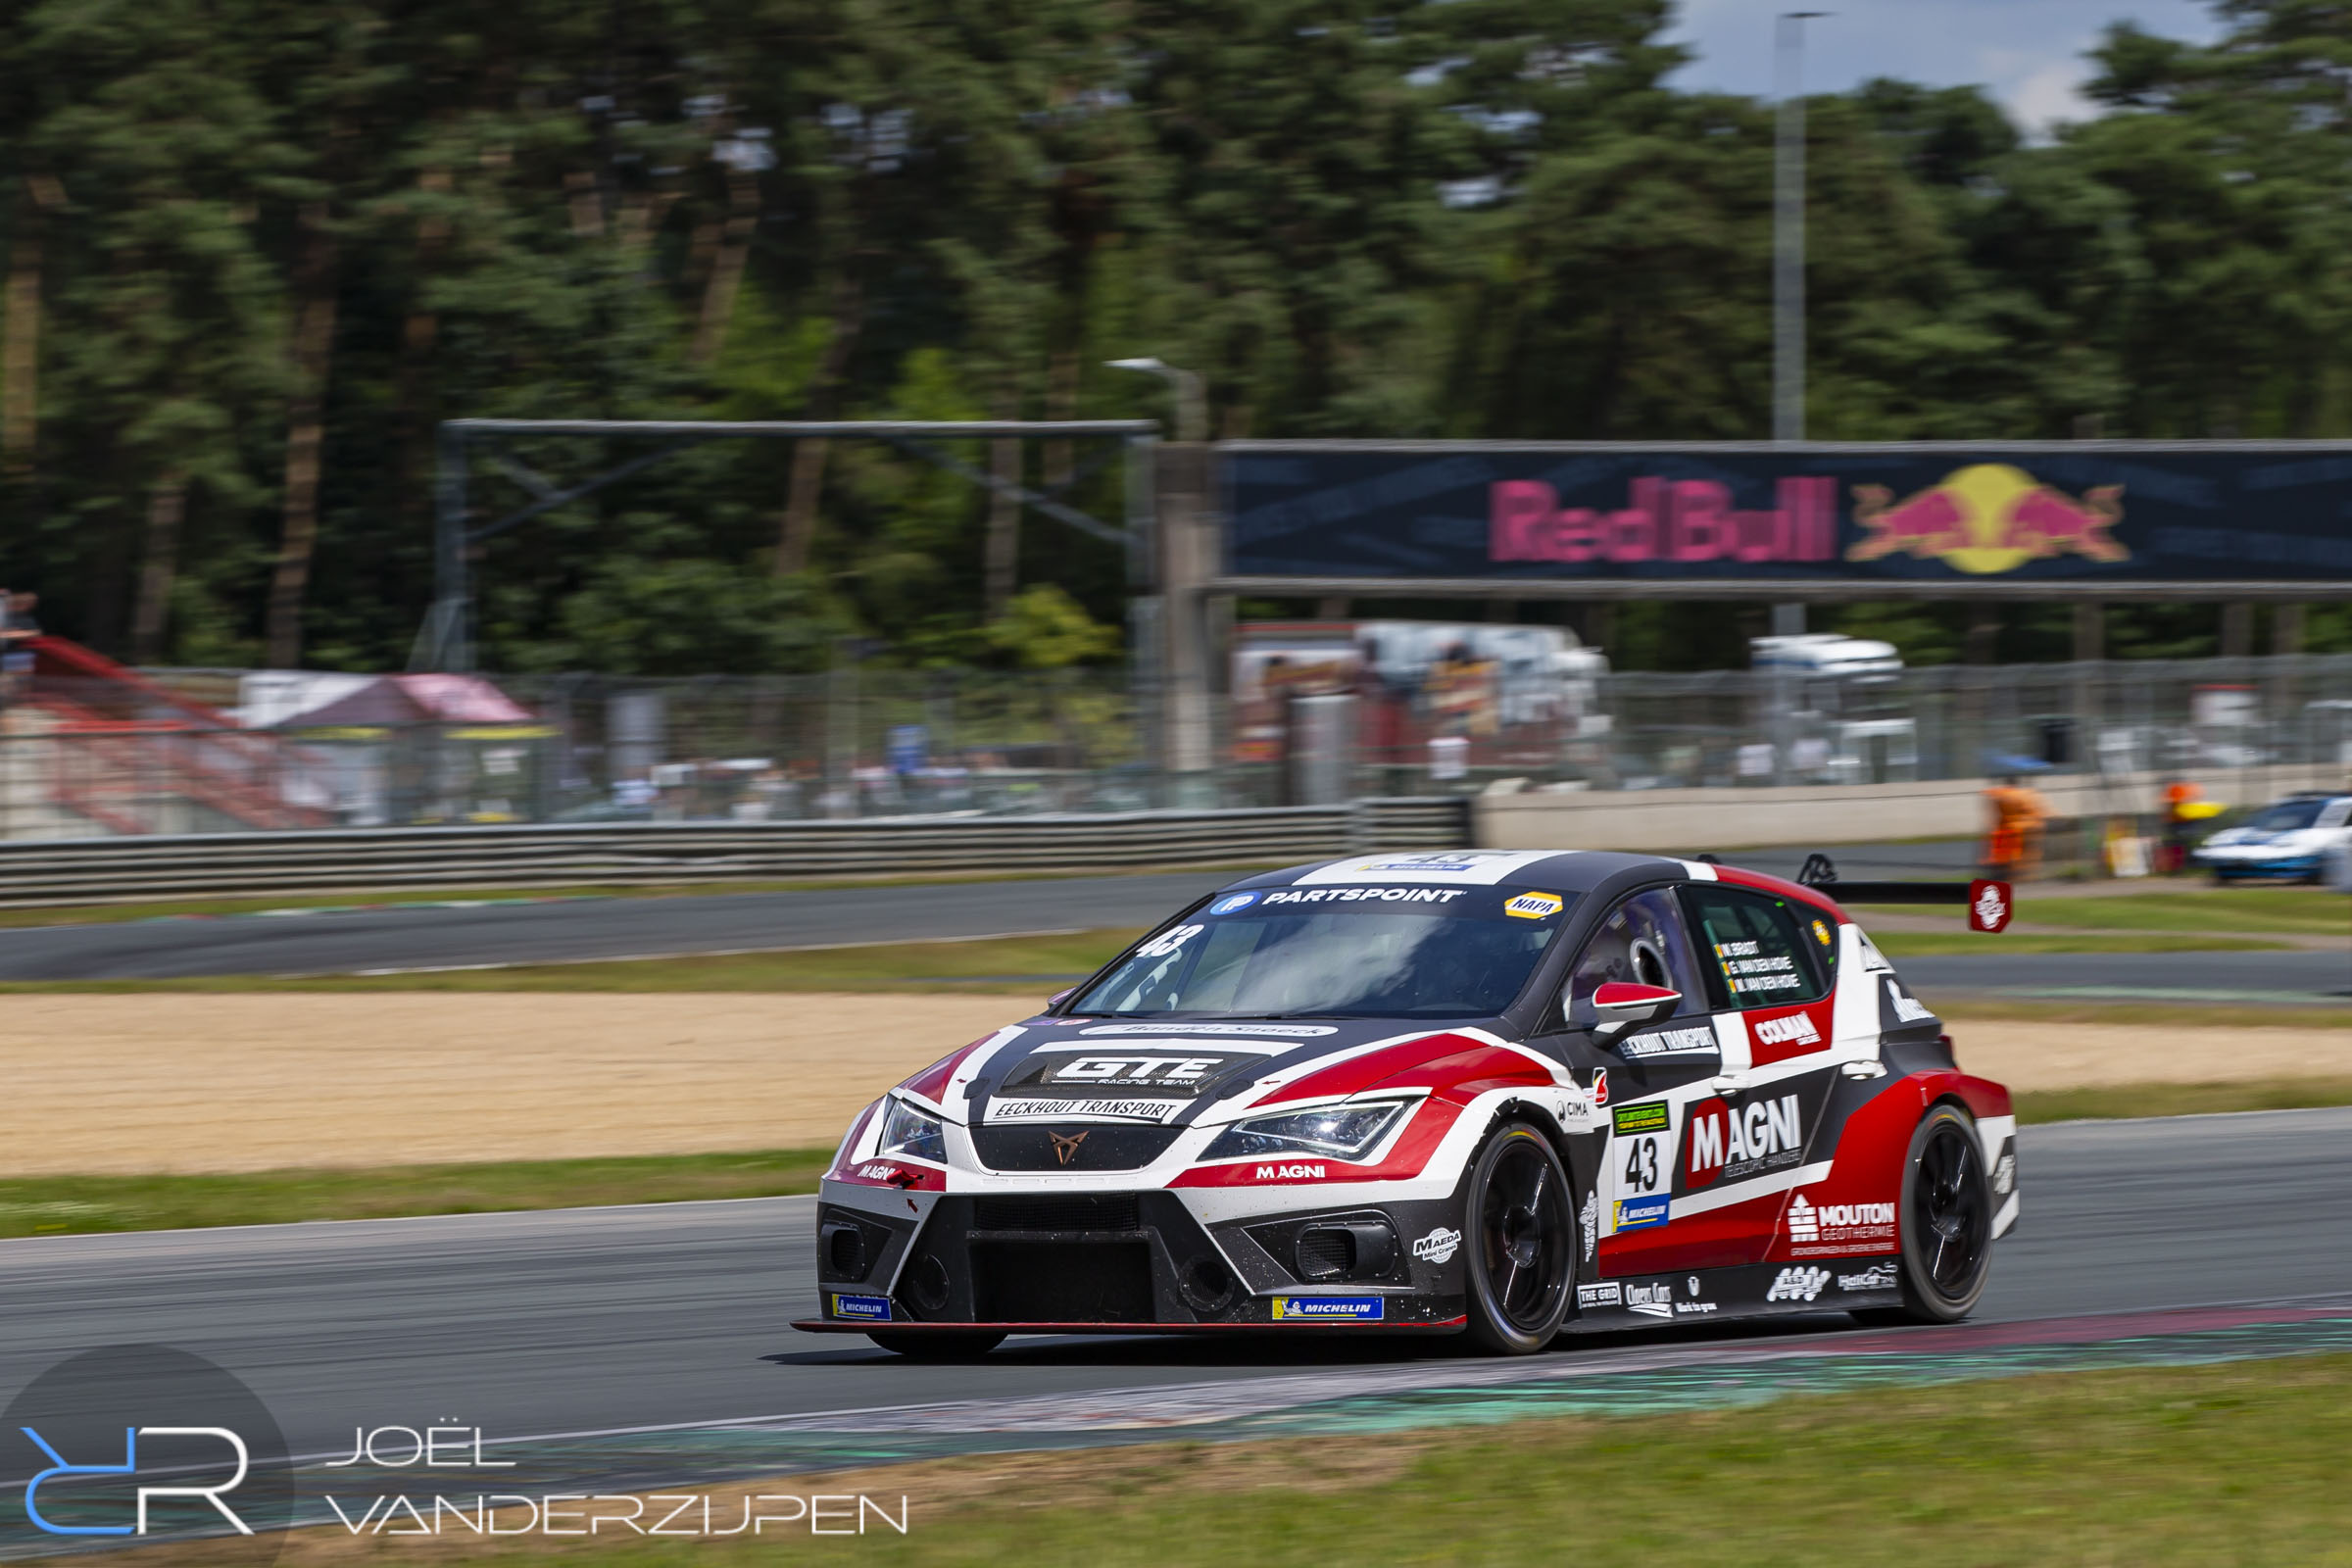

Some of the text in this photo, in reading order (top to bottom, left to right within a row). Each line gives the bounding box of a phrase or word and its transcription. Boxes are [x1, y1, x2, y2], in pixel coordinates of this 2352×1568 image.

[1489, 476, 1838, 562] Red Bull
[1261, 888, 1461, 906] PARTSPOINT
[1512, 897, 1556, 913] NAPA
[1135, 924, 1204, 957] 43
[1754, 1011, 1817, 1045] COLMAN
[1056, 1056, 1224, 1078] GTE
[996, 1100, 1176, 1119] EECKHOUT TRANSPORT
[1567, 1102, 1589, 1116] CIMA
[1691, 1094, 1801, 1173] MAGNI
[1255, 1165, 1326, 1179] MAGNI
[1625, 1136, 1658, 1193] 43
[1628, 1204, 1666, 1219] MICHELIN
[1818, 1201, 1895, 1227] MOUTON
[1415, 1233, 1460, 1253] MAEDA
[1424, 1244, 1457, 1258] Mini Cranes
[1581, 1286, 1618, 1302] THE GRID
[846, 1302, 882, 1313] MICHELIN
[1304, 1303, 1372, 1313] MICHELIN
